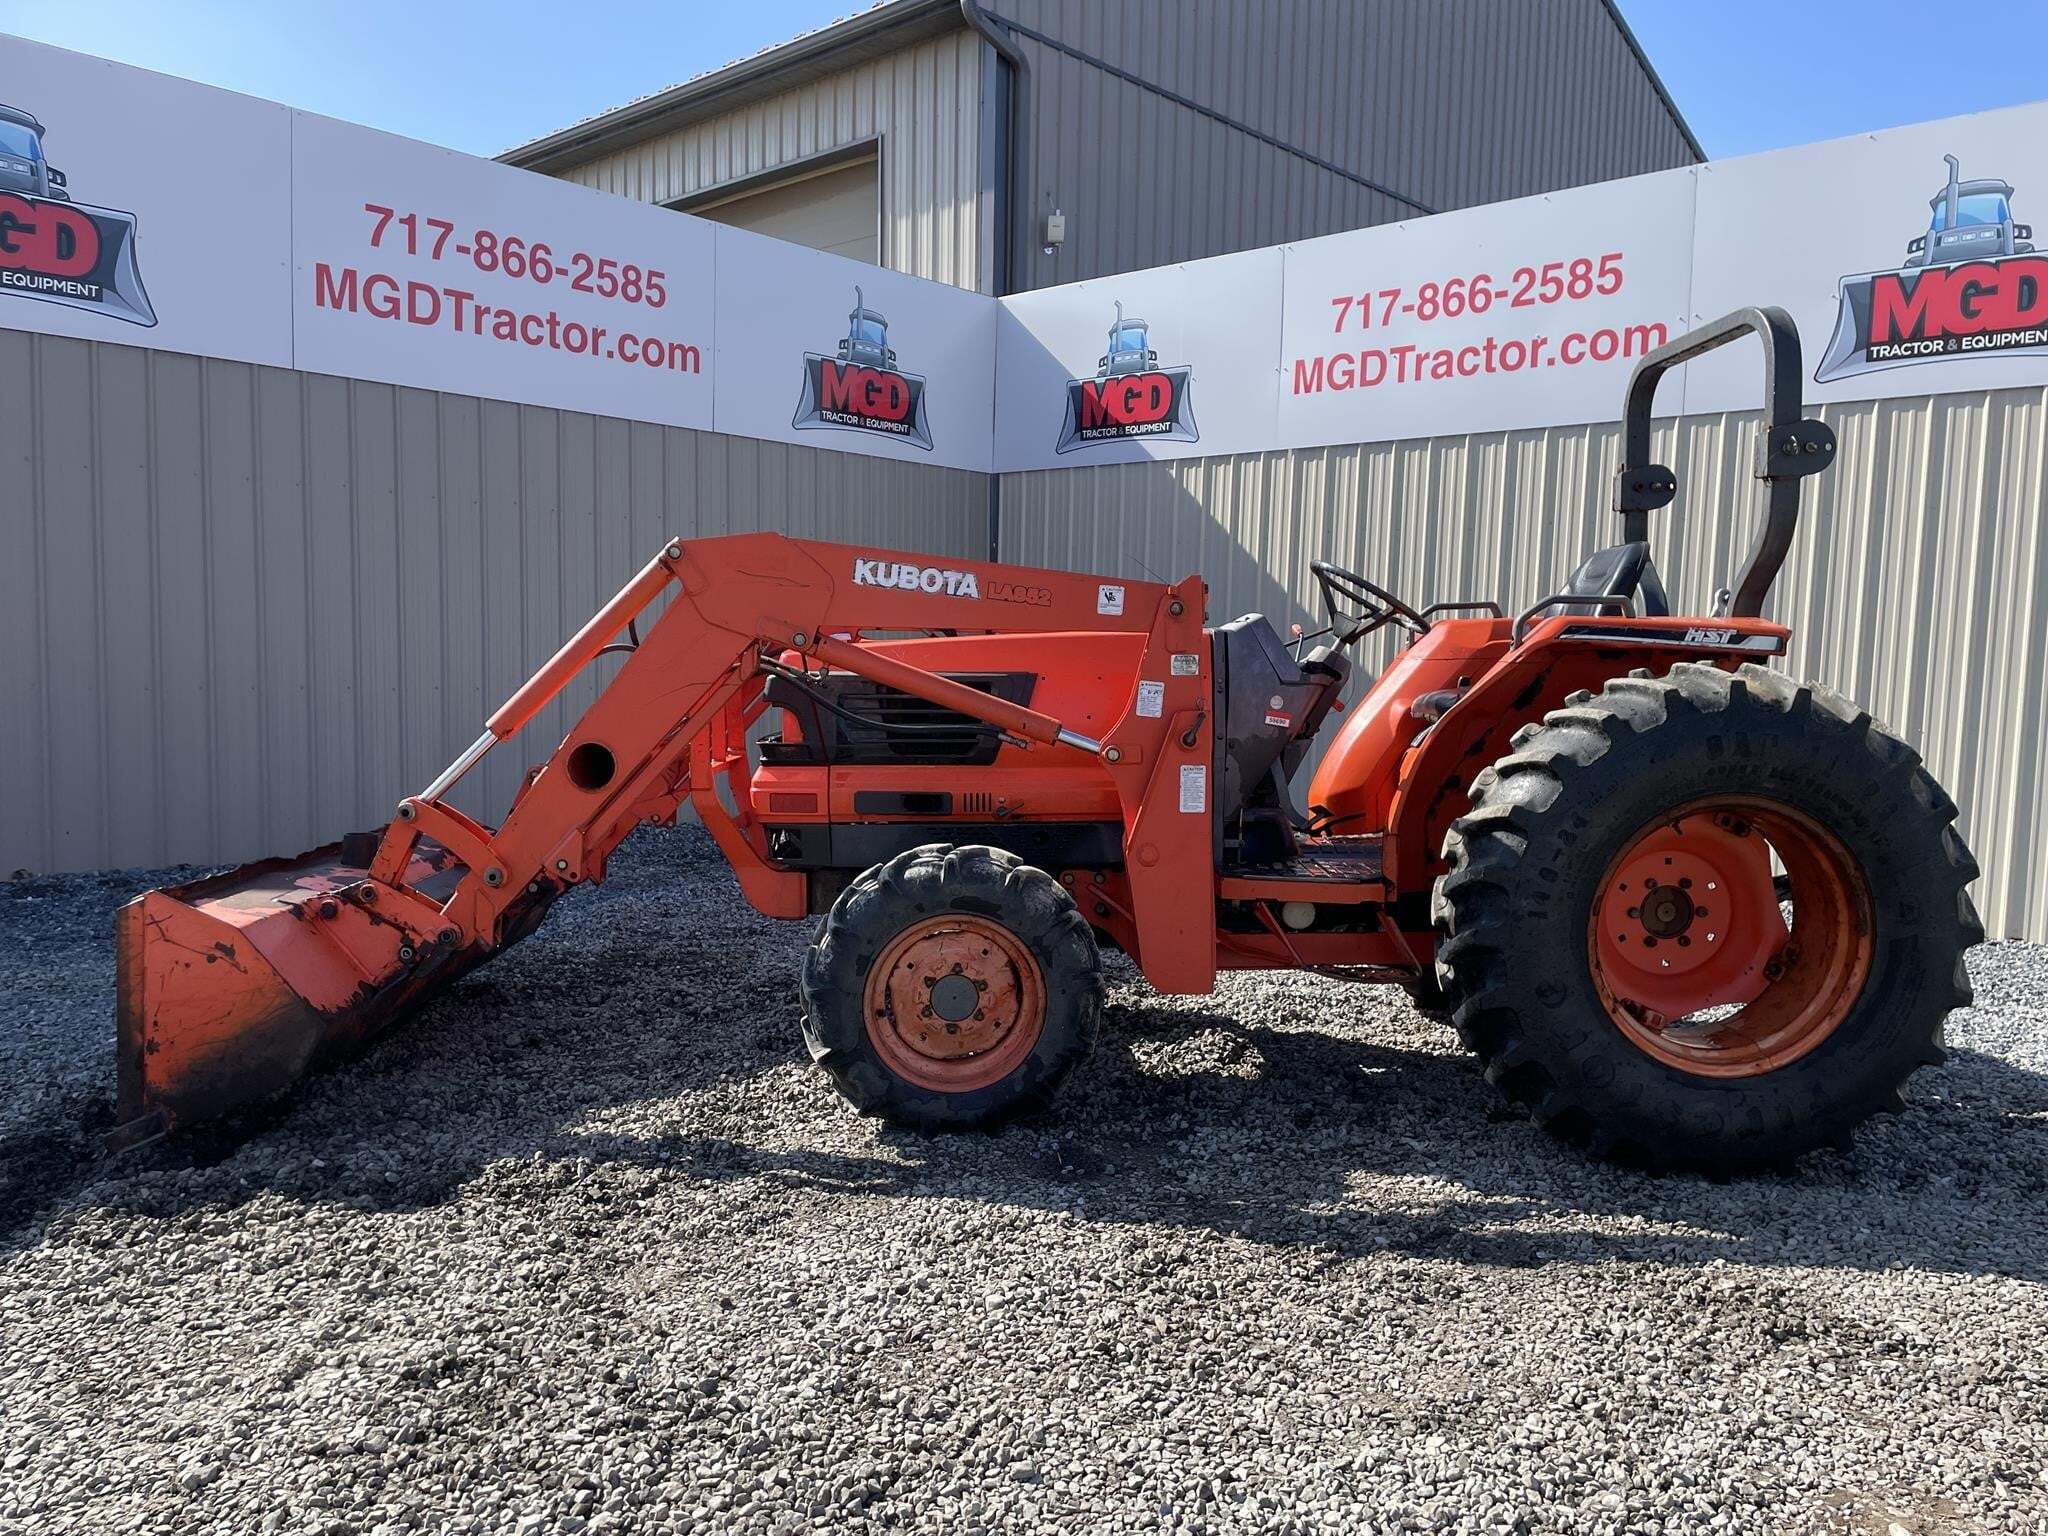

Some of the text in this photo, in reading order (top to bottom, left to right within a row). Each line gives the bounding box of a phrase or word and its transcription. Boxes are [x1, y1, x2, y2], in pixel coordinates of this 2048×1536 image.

[0, 194, 99, 277] GD
[366, 205, 668, 307] 717-866-2585
[2, 271, 99, 297] EQUIPMENT
[1331, 252, 1623, 334] 717-866-2585
[1870, 257, 2048, 344] MGD
[315, 264, 701, 373] MGDTractor.com
[1870, 330, 2048, 359] TRACTOR & EQUIPMEN
[1292, 322, 1668, 395] MGDTractor.com
[821, 359, 910, 421] MGD
[1082, 372, 1172, 428] MGD
[821, 410, 859, 425] TRACTOR
[866, 418, 909, 433] EQUIPMENT
[1082, 427, 1118, 439] TRACTOR
[1125, 421, 1171, 435] EQUIPMENT
[851, 557, 981, 599] KUBOTA
[1684, 627, 1738, 645] HST
